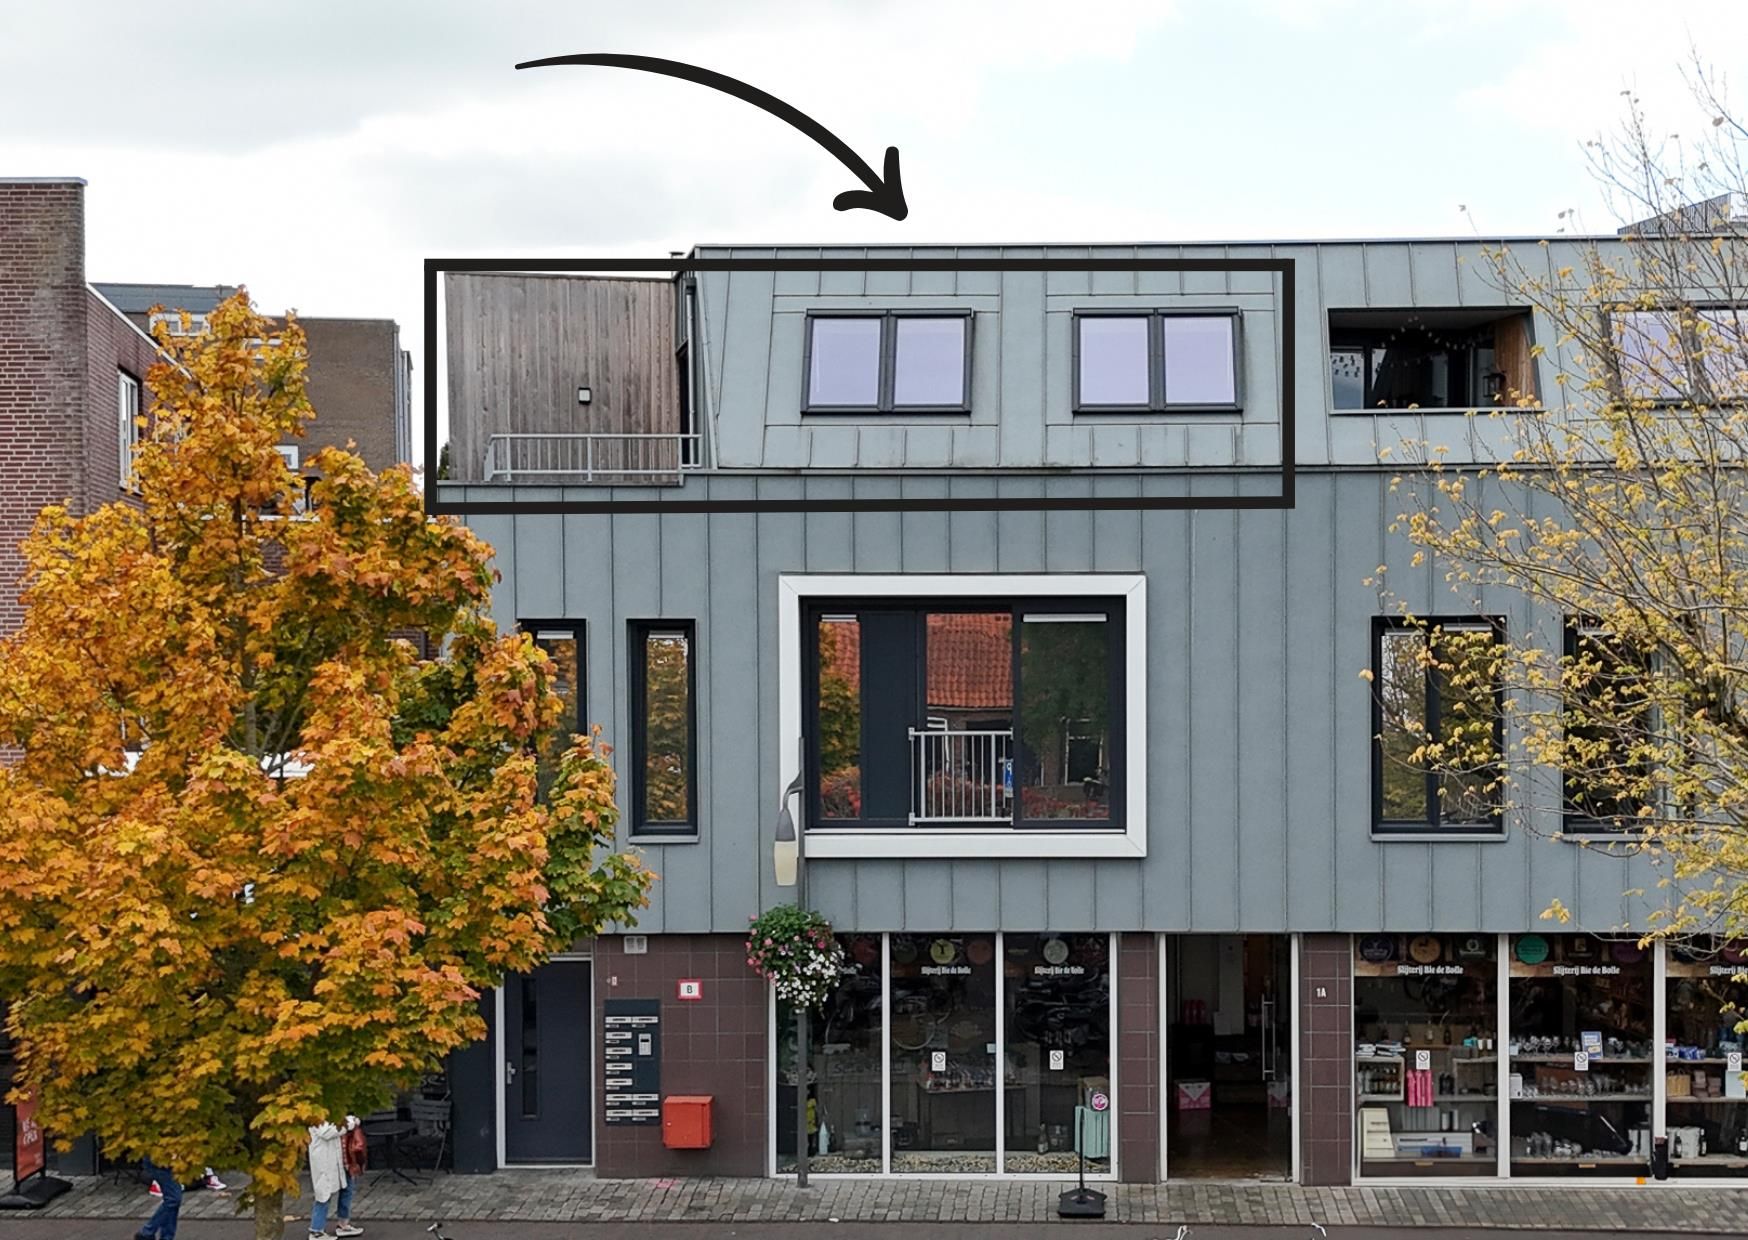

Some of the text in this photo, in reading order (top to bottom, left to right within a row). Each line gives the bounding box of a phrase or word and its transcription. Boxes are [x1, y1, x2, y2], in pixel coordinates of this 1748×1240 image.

[1436, 965, 1444, 974] de
[1592, 965, 1601, 974] de
[1316, 986, 1327, 998] 1A
